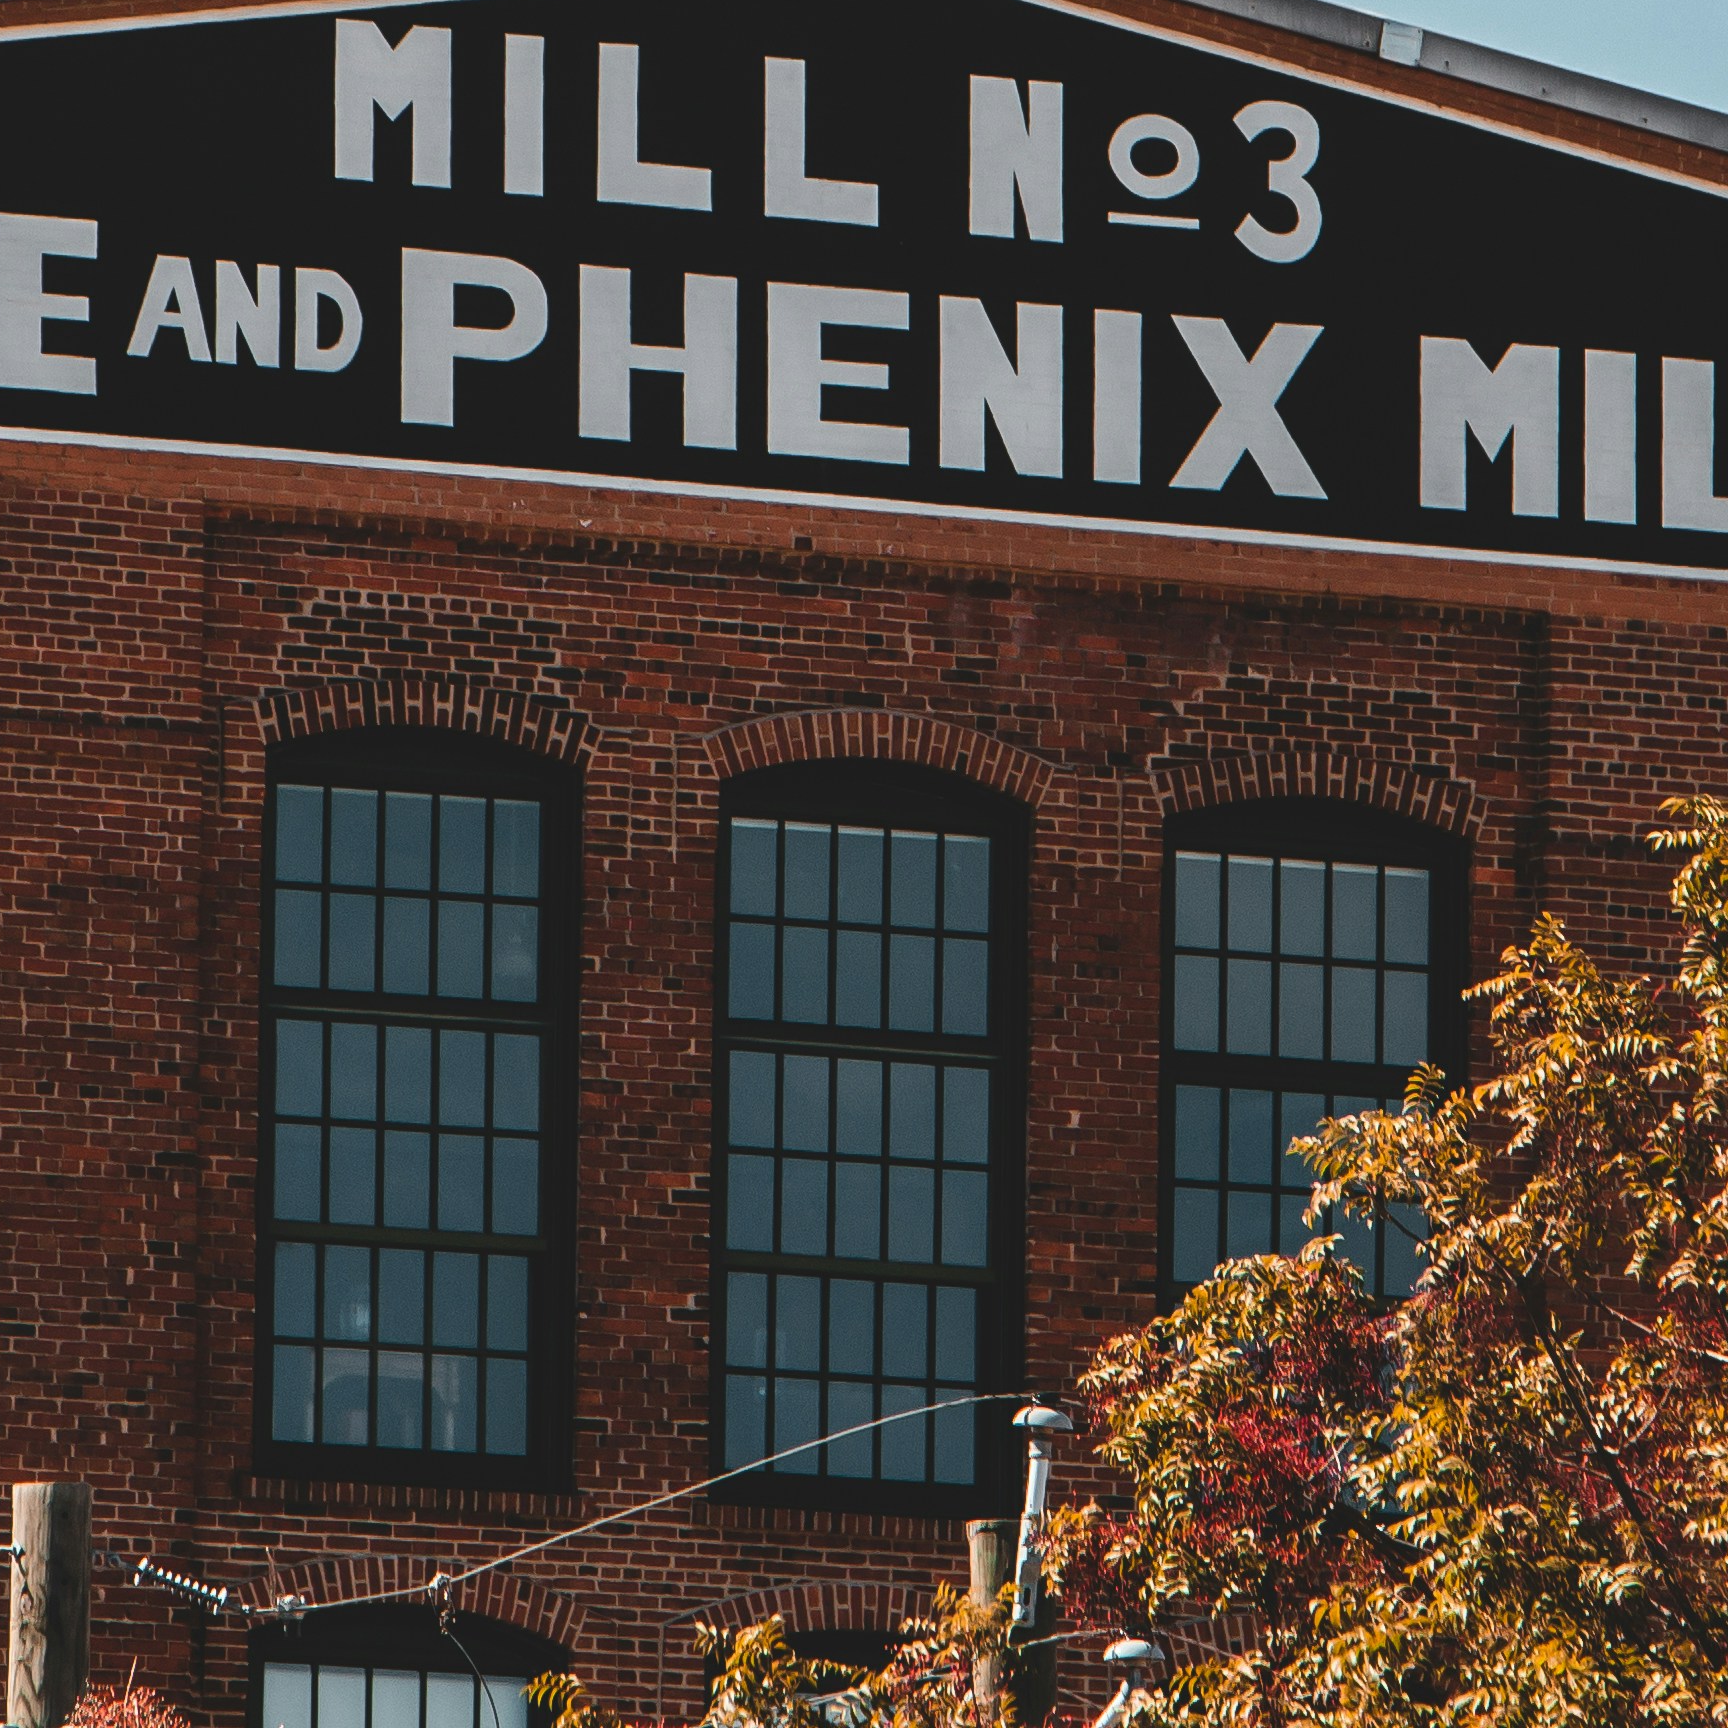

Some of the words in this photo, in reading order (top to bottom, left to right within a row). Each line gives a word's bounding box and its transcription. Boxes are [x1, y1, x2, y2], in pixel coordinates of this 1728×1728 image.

[330, 16, 881, 229] MILL
[124, 252, 365, 374] AND
[398, 245, 1330, 502] PHENIX
